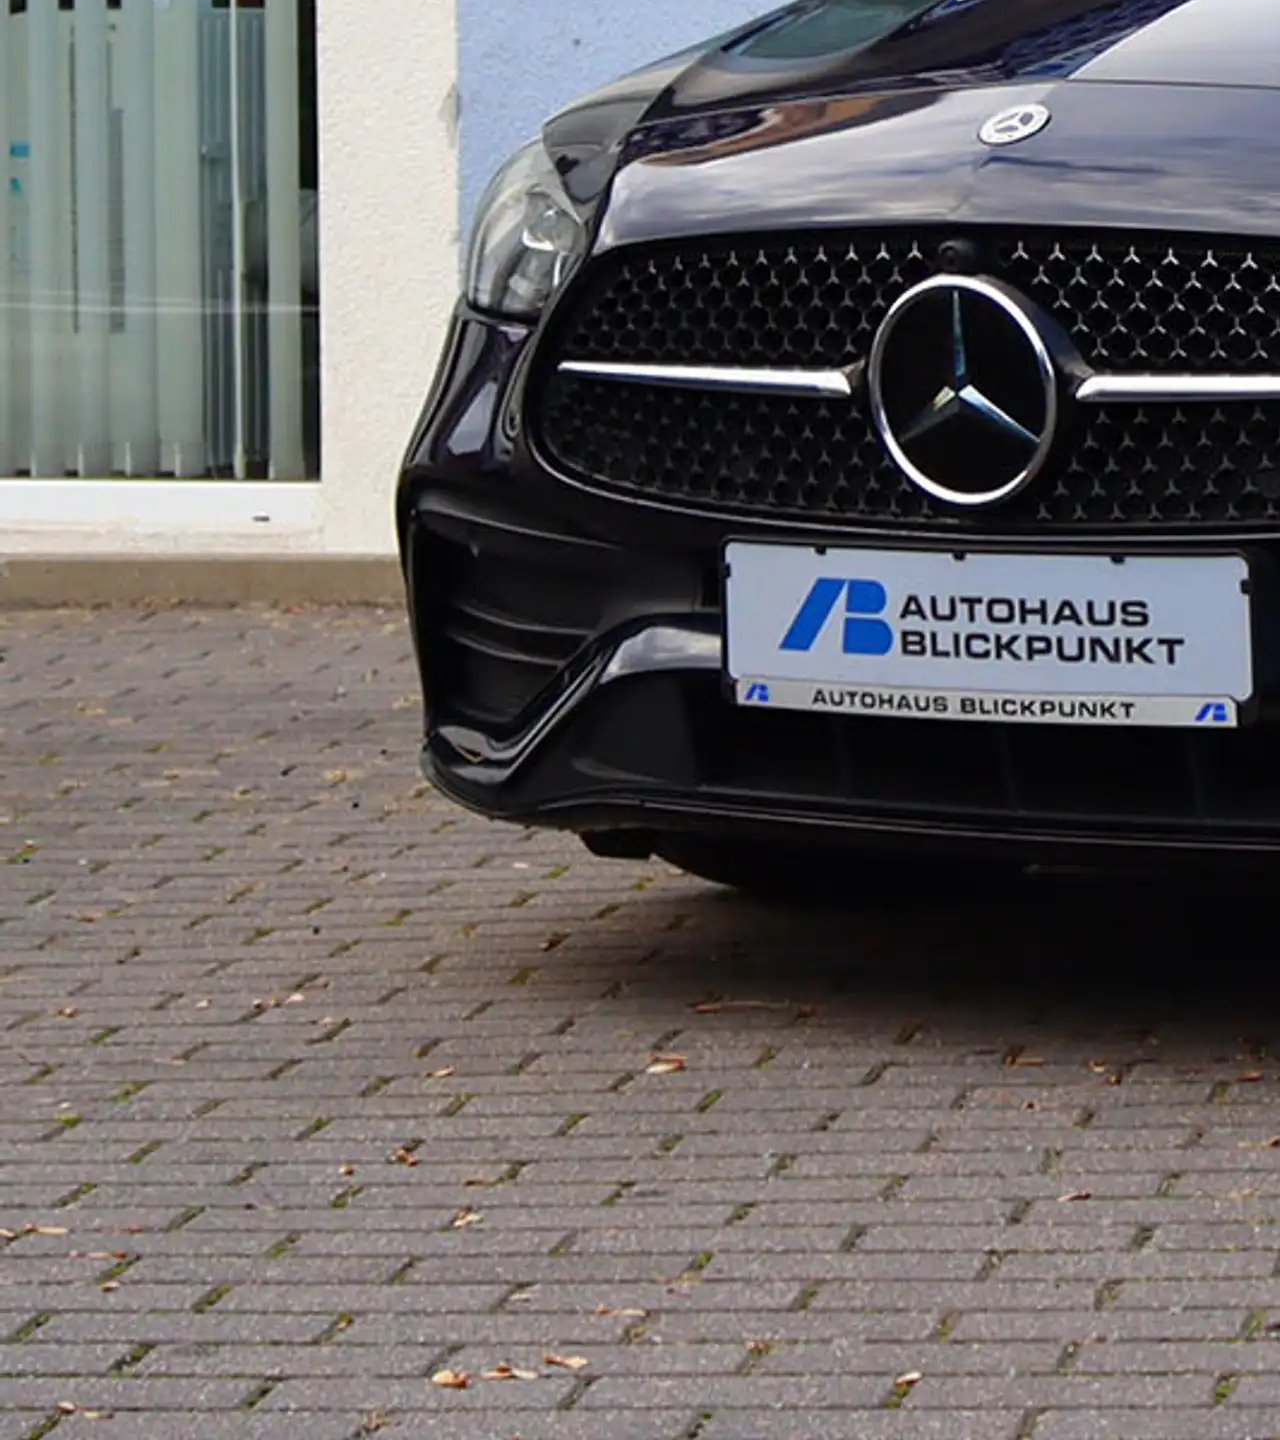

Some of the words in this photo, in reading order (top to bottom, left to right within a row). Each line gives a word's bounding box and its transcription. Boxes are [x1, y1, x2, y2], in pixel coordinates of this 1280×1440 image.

[899, 594, 1150, 628] AUTOHAUS
[900, 629, 1185, 666] BLICKPUNKT
[811, 688, 949, 714] AUTOHAUS
[959, 696, 1137, 720] BLICKPUNKT
